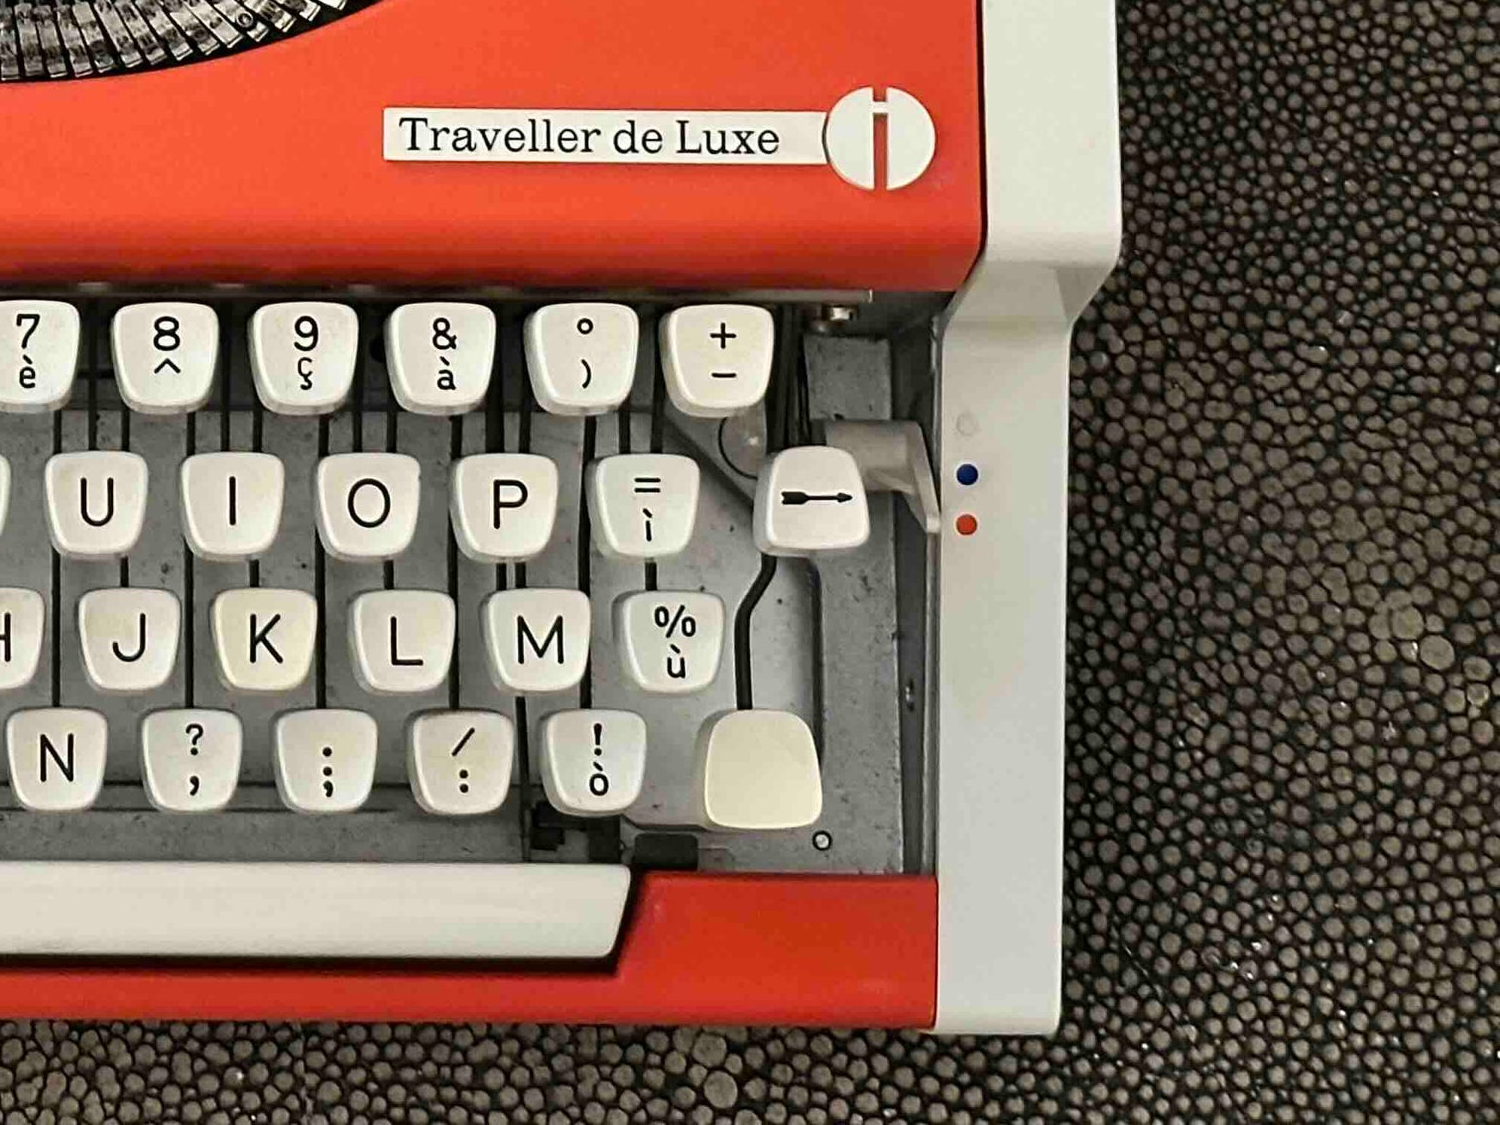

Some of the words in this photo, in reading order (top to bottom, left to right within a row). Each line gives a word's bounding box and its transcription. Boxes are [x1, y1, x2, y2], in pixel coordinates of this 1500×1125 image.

[398, 117, 602, 154] Traveller
[613, 119, 663, 155] de
[675, 119, 780, 155] Luxe
[15, 313, 41, 350] 7
[153, 315, 181, 352] 8
[293, 315, 319, 352] 9
[432, 317, 458, 351] &
[709, 322, 737, 350] +
[18, 354, 36, 389] è
[297, 356, 313, 391] ç
[436, 355, 457, 391] à
[581, 359, 592, 389] )
[80, 477, 114, 527] U
[228, 475, 237, 526] I
[347, 478, 391, 529] O
[634, 477, 662, 494] =
[493, 479, 529, 530] P
[112, 612, 146, 663] J
[249, 613, 284, 664] K
[654, 604, 697, 639] %
[390, 616, 424, 667] L
[516, 615, 565, 665] M
[666, 643, 686, 679] ù
[185, 723, 204, 756] ?
[451, 727, 476, 757] /
[593, 722, 603, 757] !
[39, 733, 74, 783] N
[589, 761, 609, 797] ò
